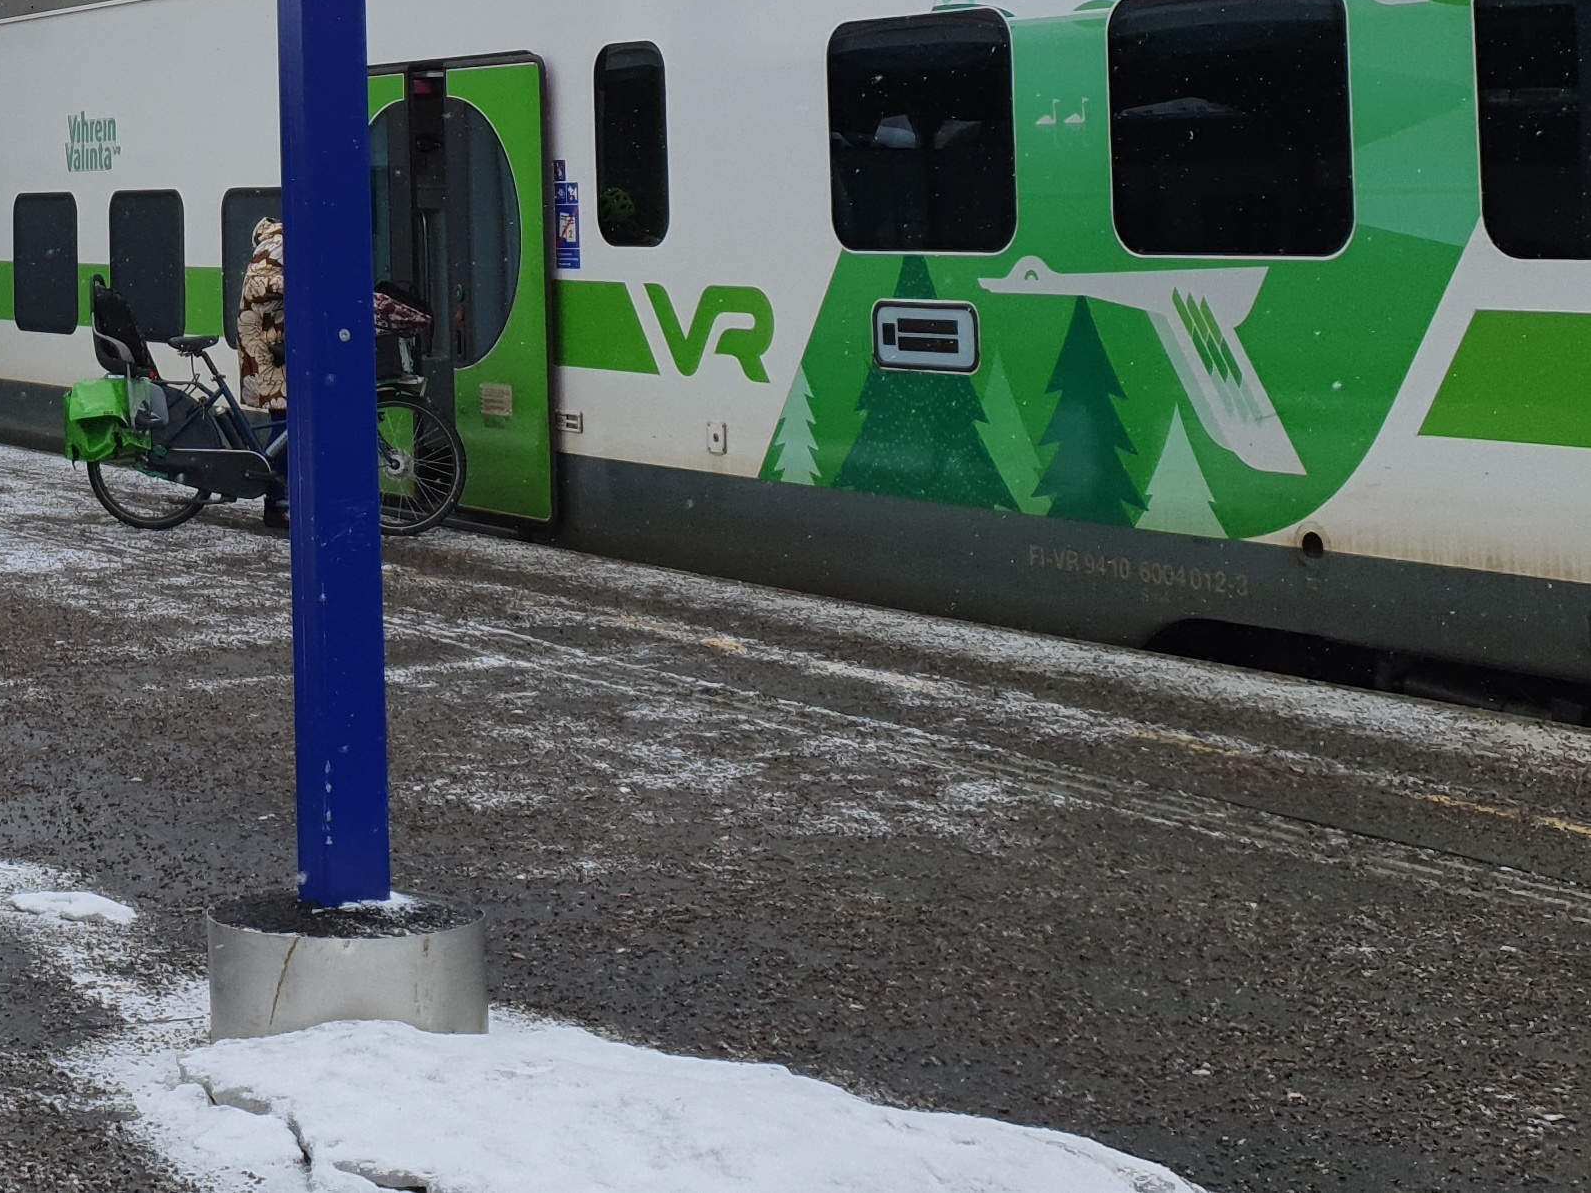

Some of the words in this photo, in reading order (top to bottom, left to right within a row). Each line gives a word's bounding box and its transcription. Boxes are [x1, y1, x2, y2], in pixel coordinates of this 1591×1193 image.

[67, 110, 117, 144] Vihrein
[65, 142, 113, 173] Valinta
[643, 282, 775, 384] VR
